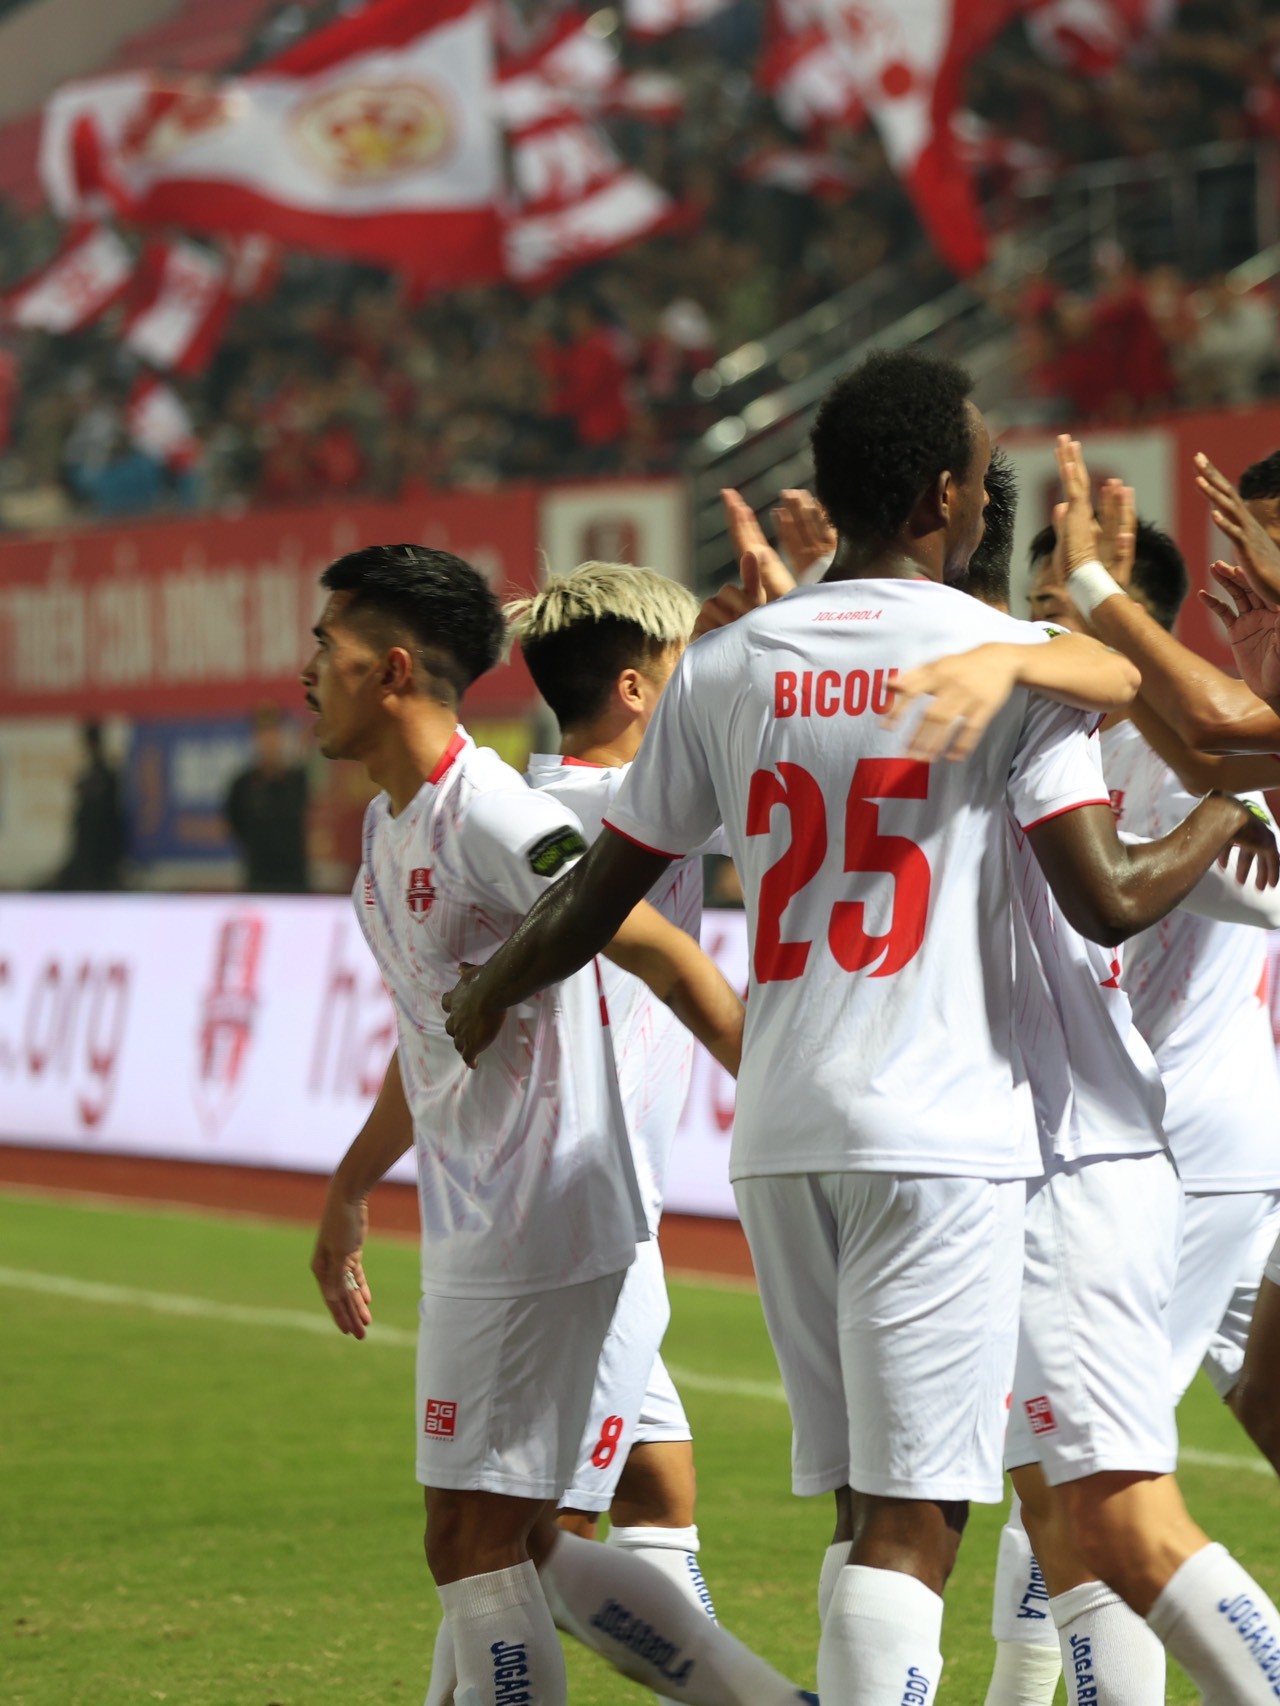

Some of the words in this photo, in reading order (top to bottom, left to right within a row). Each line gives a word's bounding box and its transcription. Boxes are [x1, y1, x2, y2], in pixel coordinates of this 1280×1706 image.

[811, 609, 883, 621] JOGARBOLA
[774, 668, 898, 719] BICOU
[746, 757, 931, 984] 25
[591, 1415, 623, 1470] 8
